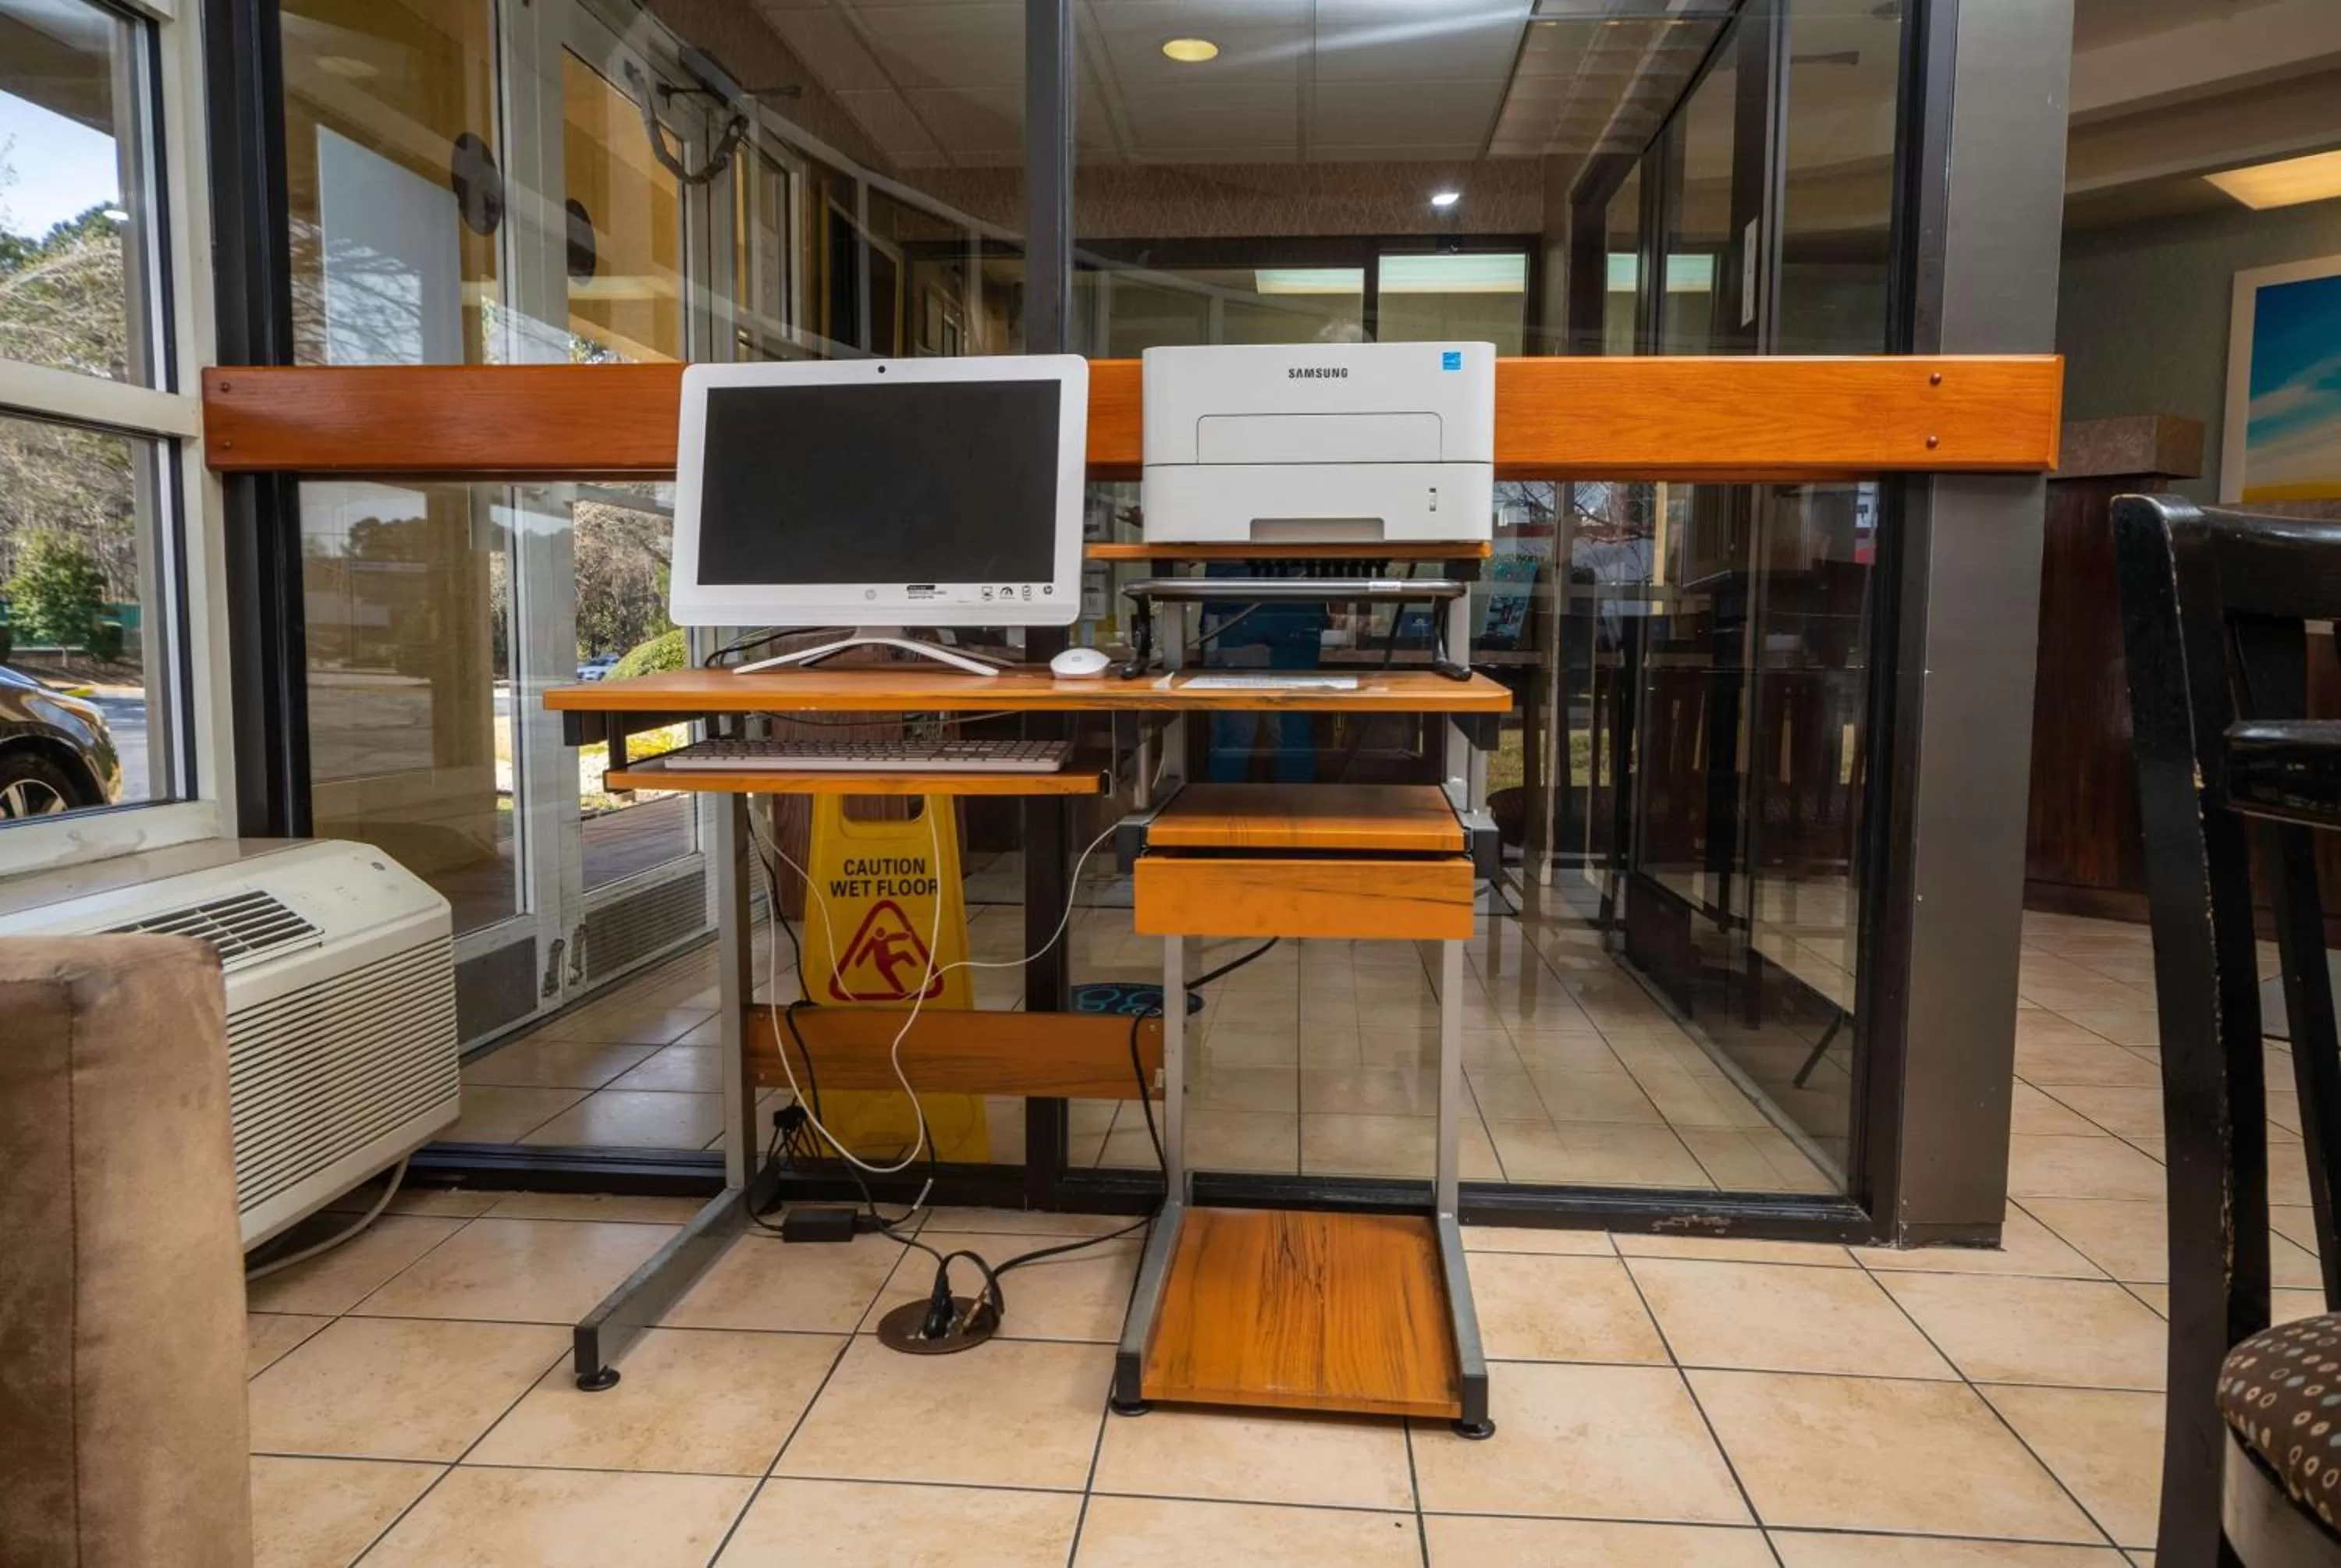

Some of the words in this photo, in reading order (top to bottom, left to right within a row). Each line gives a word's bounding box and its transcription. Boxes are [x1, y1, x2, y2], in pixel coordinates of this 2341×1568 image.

[1288, 367, 1348, 378] SAMSUNG
[844, 858, 925, 875] CAUTION
[829, 879, 872, 897] WET
[876, 878, 938, 896] FLOOR
